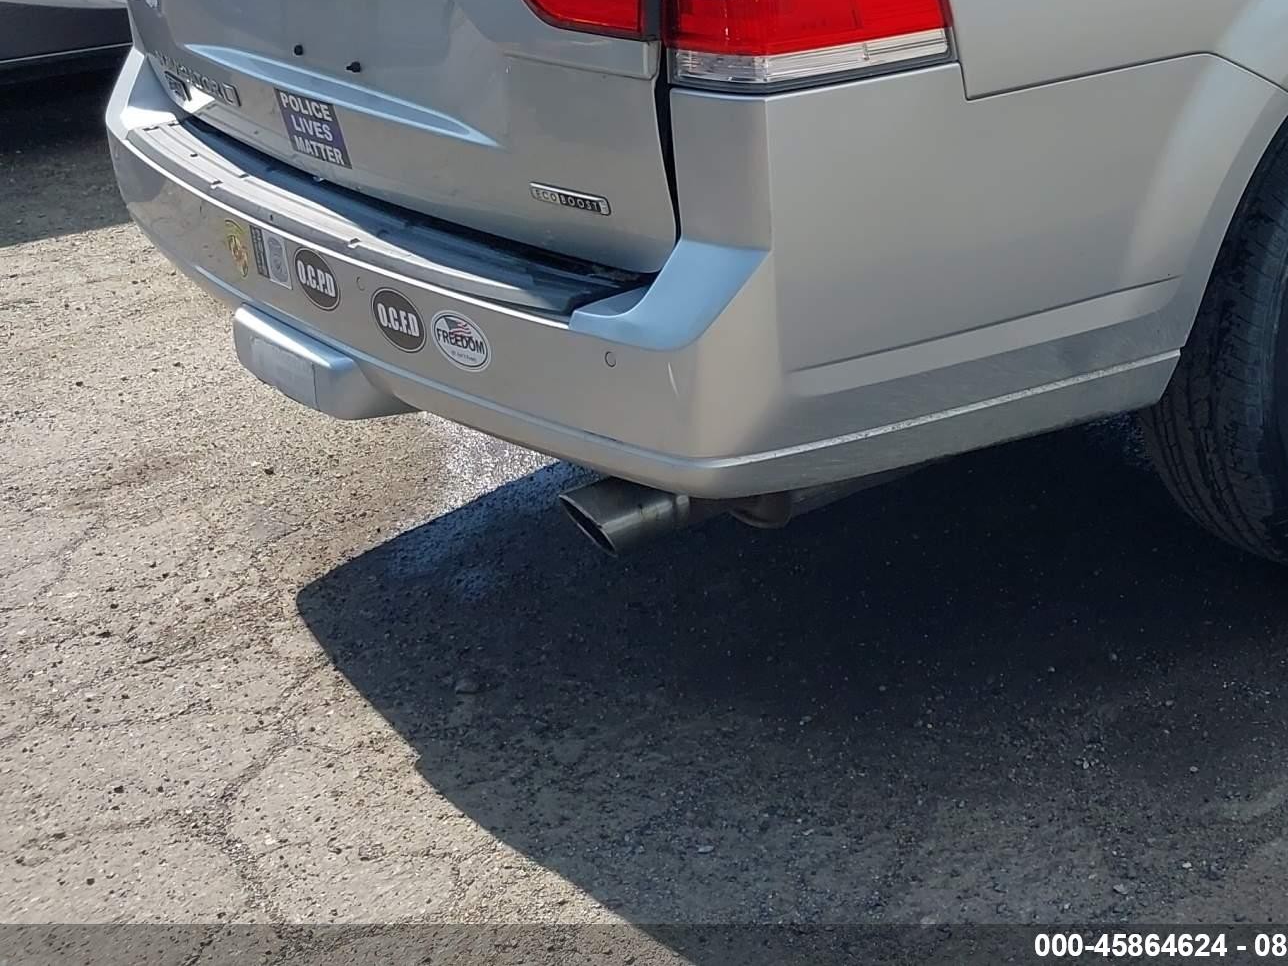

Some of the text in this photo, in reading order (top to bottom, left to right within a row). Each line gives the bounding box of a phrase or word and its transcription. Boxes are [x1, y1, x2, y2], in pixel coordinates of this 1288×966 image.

[279, 92, 333, 121] POLICE
[290, 114, 334, 141] LIVES
[293, 135, 345, 165] MATTER
[436, 328, 486, 355] FREEDOM
